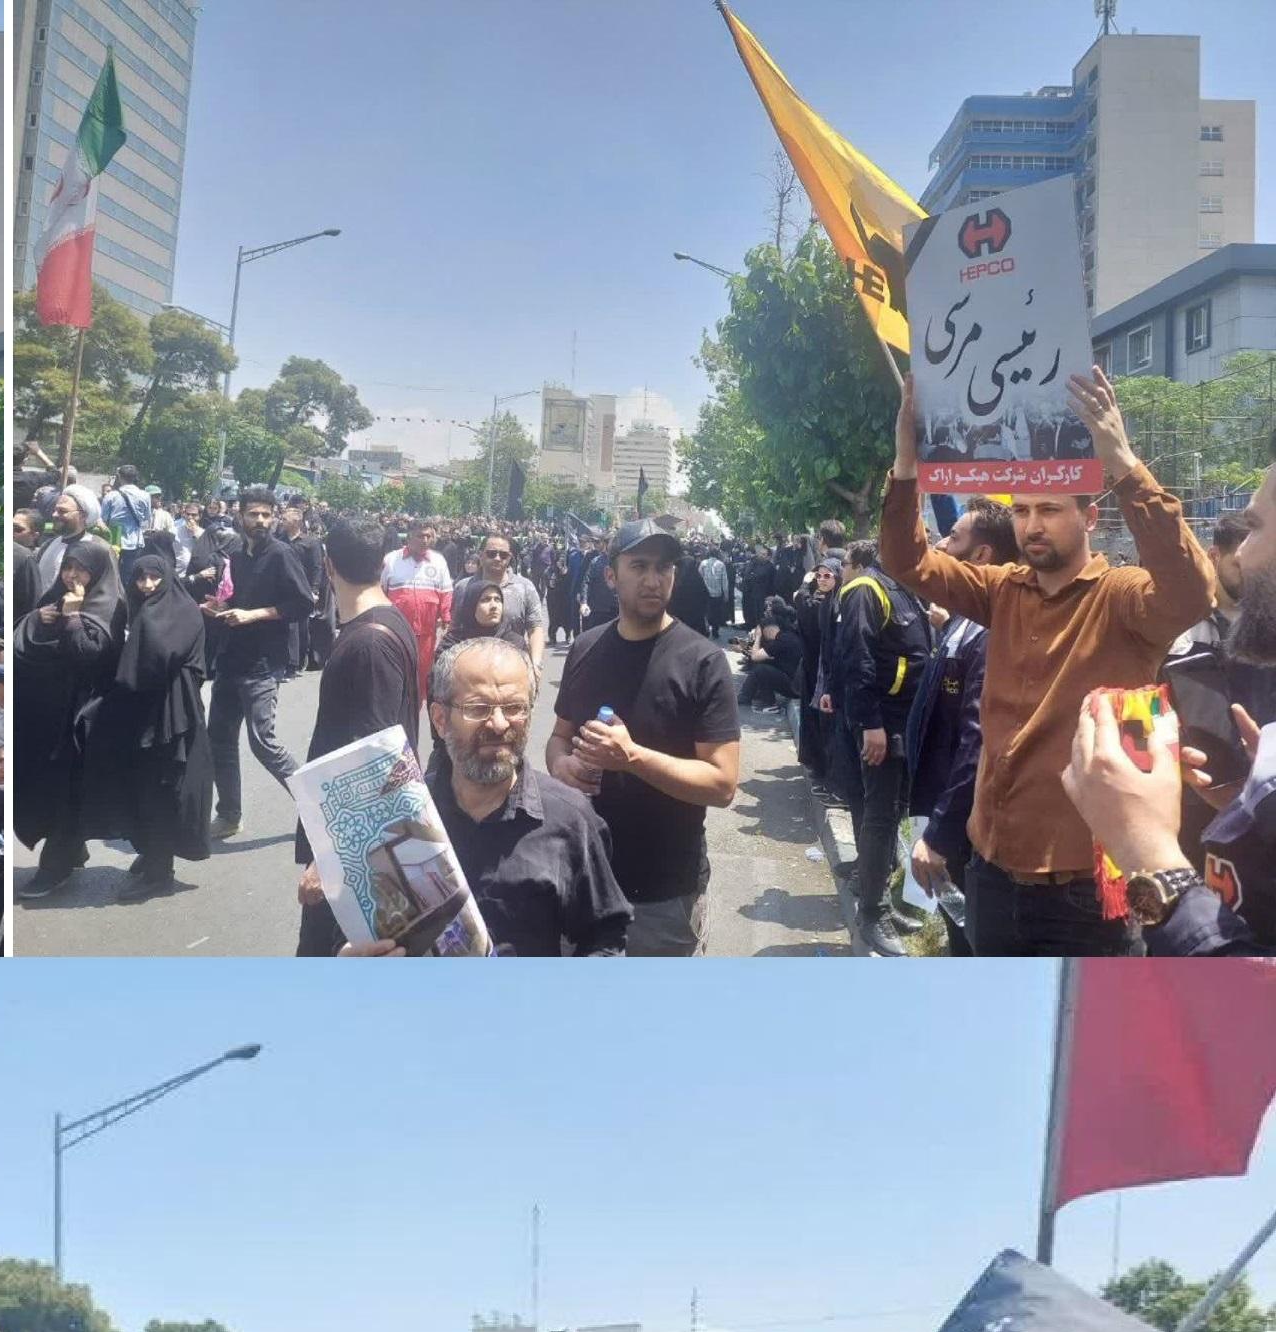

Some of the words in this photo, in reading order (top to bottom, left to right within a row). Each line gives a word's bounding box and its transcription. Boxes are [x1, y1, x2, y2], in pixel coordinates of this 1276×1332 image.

[960, 257, 1015, 282] HEPCO
[925, 292, 982, 379] مرسی
[928, 468, 953, 486] اراک
[992, 466, 1027, 486] شرکت
[1029, 464, 1083, 486] کارگران
